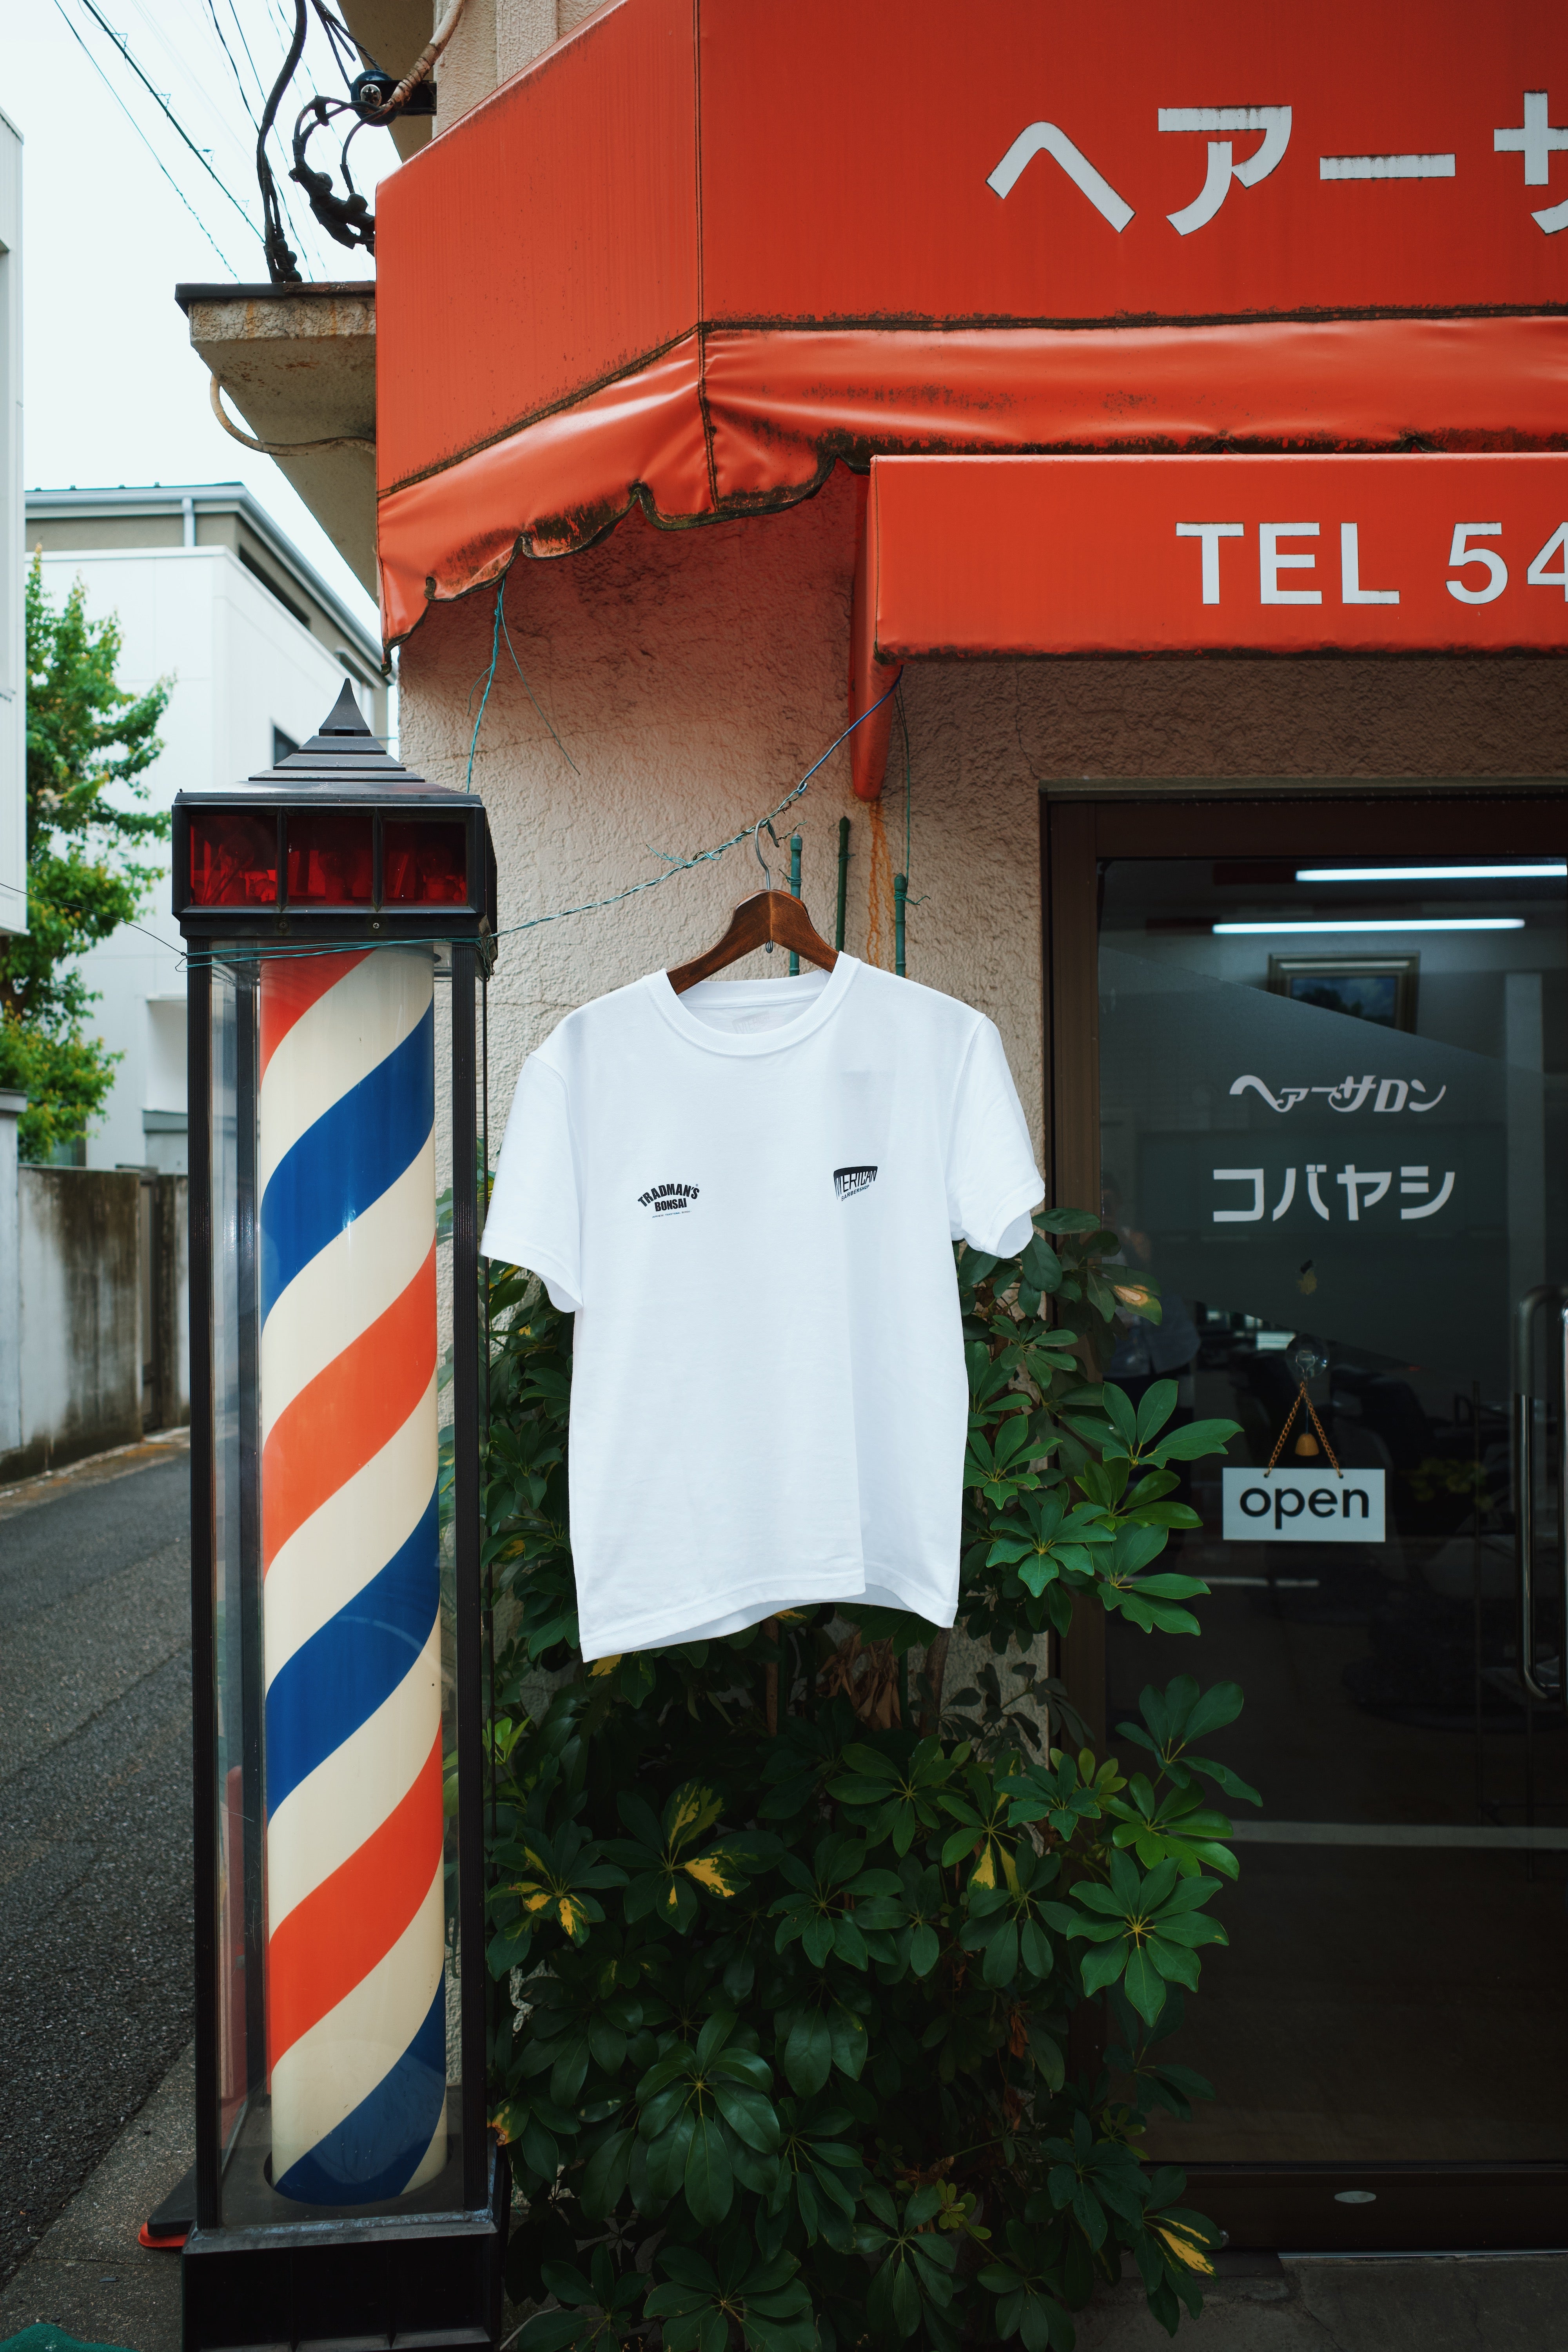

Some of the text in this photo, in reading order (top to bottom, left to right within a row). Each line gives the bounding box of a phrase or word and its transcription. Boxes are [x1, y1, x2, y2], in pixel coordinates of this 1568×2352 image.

[1176, 522, 1568, 604] TEL 54
[638, 1184, 700, 1207] TRADMAN'S
[655, 1198, 687, 1212] BONSAI
[841, 1185, 869, 1201] BARBERSHOP
[1213, 1165, 1455, 1222] コバヤシ
[1240, 1488, 1369, 1530] open
